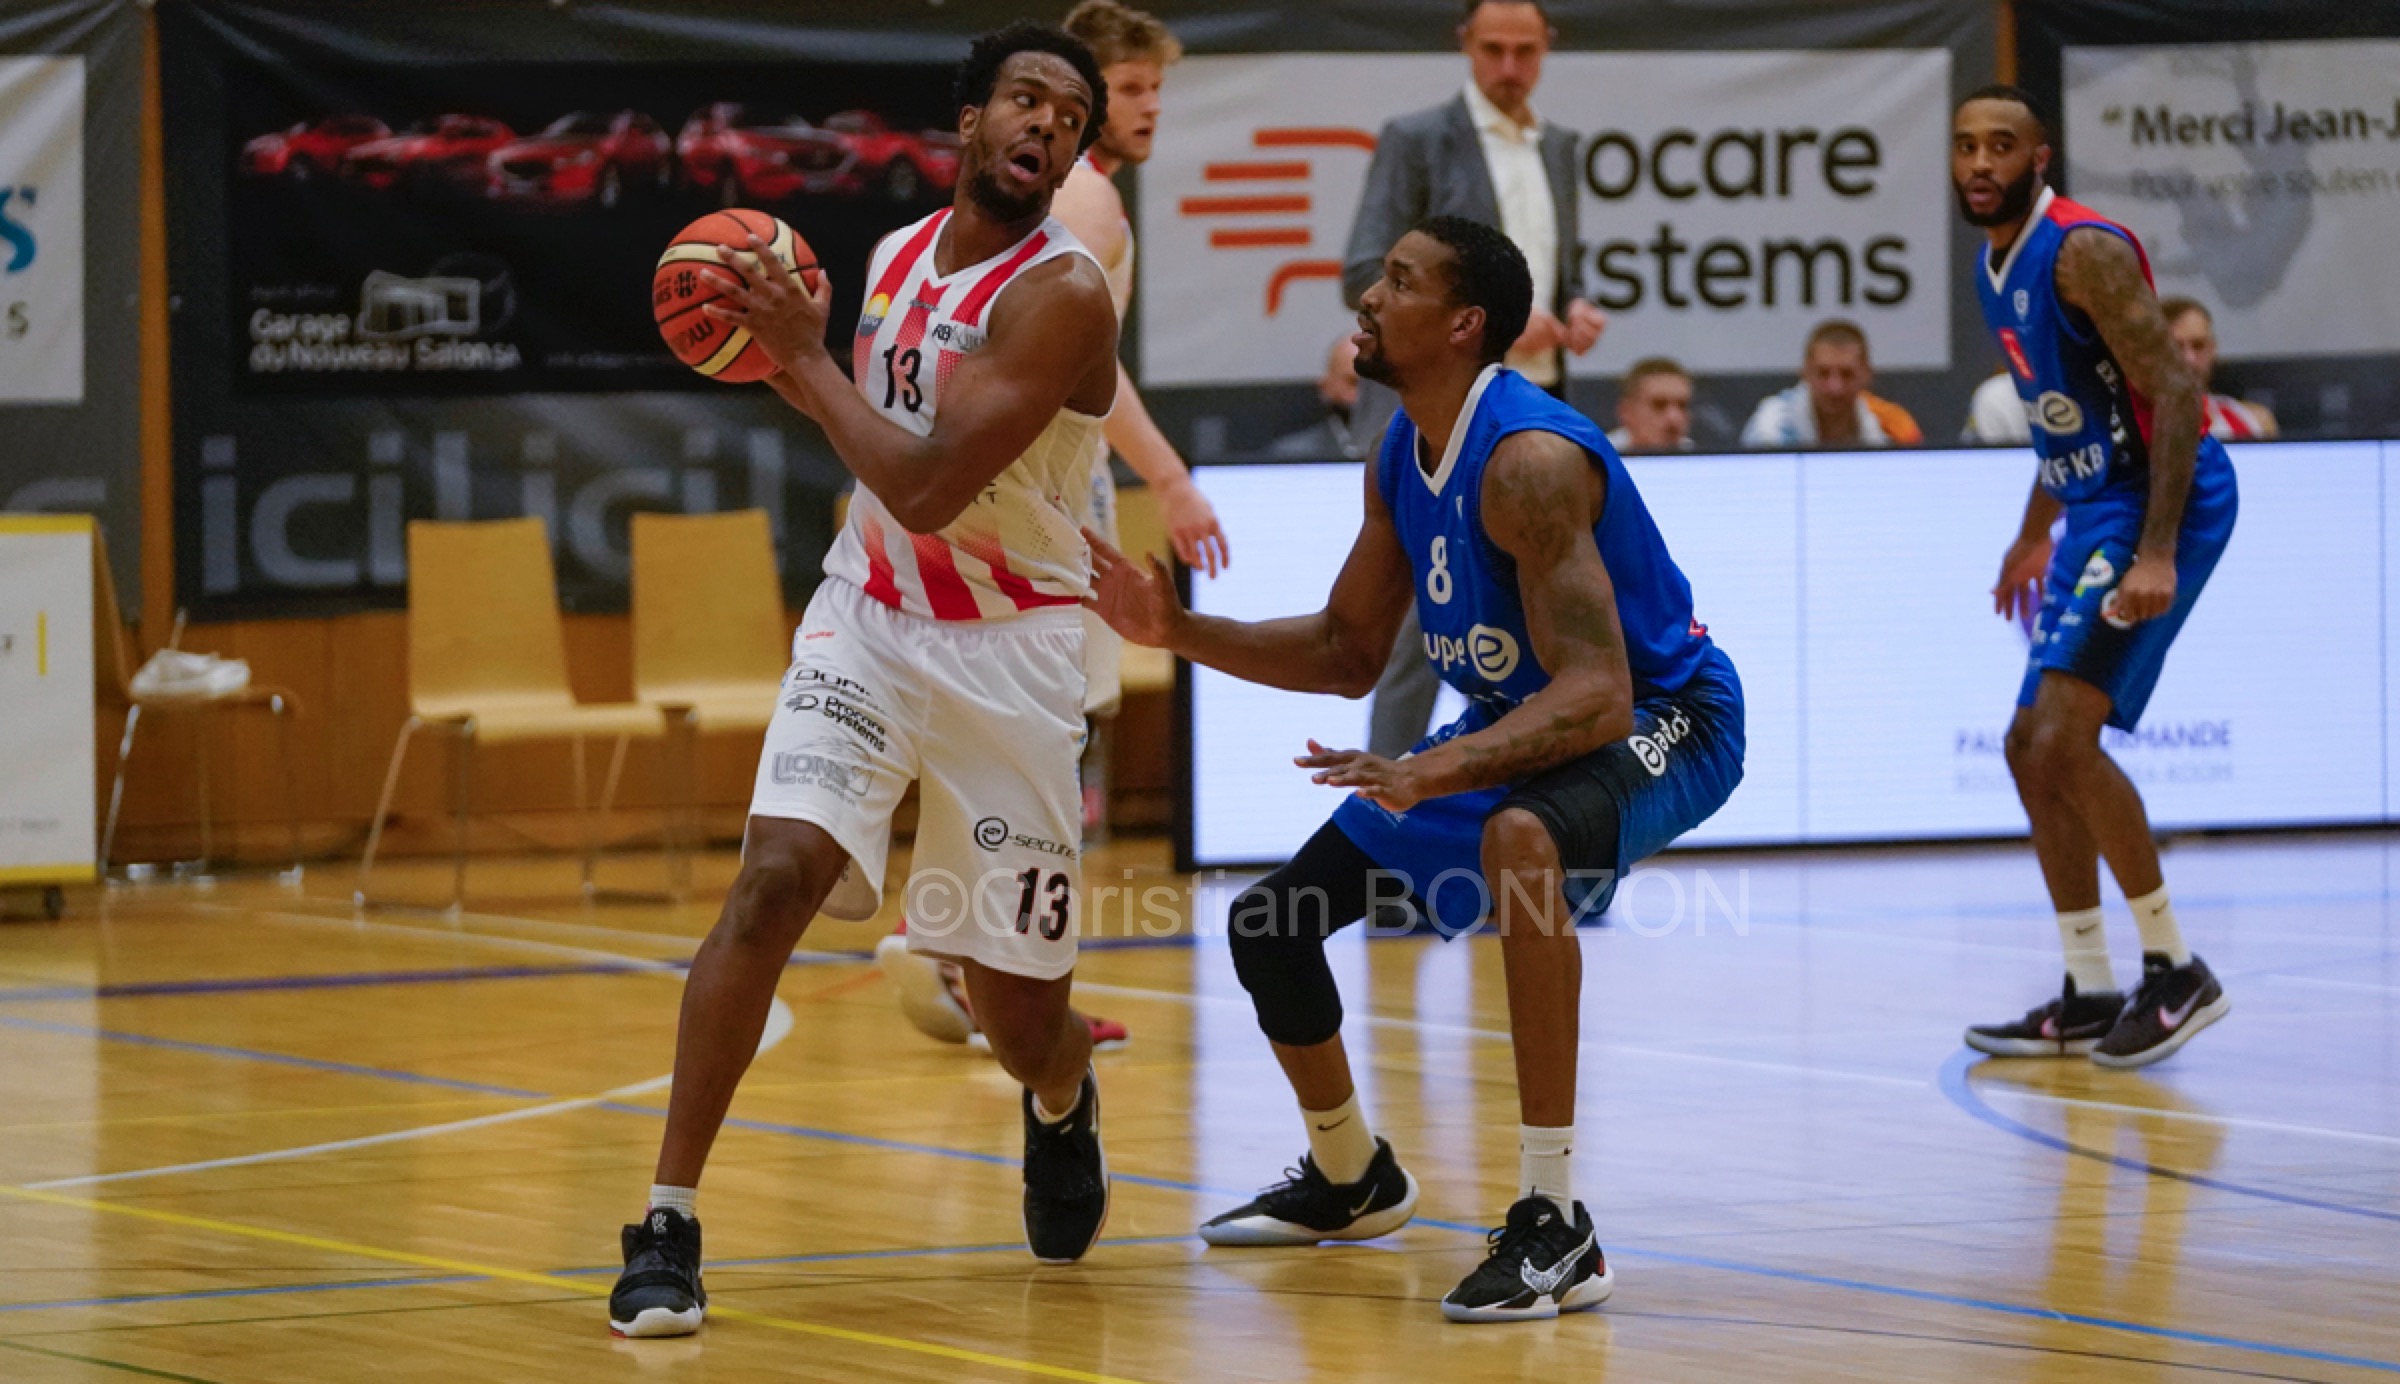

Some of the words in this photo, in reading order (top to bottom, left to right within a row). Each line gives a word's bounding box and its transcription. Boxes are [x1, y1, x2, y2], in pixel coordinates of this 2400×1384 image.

[1577, 126, 1882, 200] ocare
[1575, 222, 1913, 312] stems
[882, 344, 923, 413] 13
[1427, 535, 1453, 604] 8
[1015, 867, 1071, 941] 13
